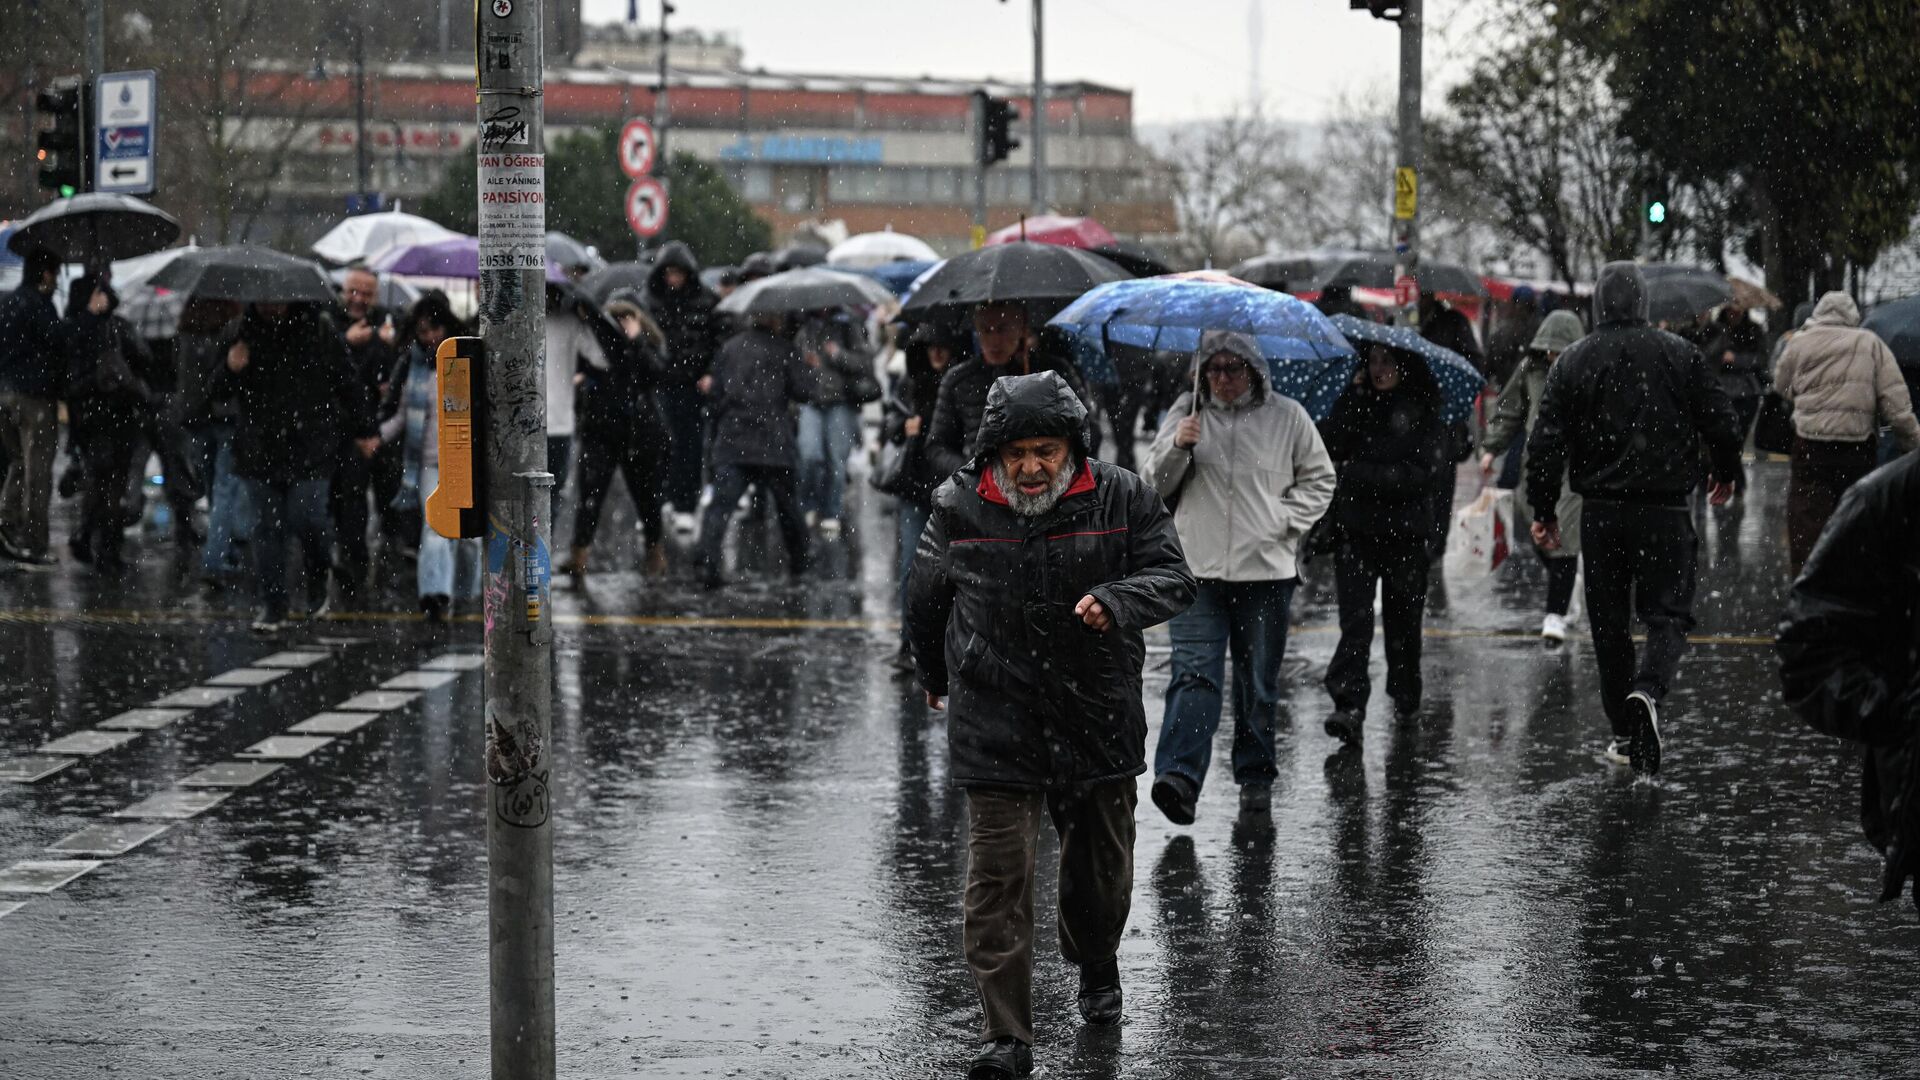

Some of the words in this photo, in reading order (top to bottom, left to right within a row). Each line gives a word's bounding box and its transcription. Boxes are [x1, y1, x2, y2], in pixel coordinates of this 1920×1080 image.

[479, 156, 500, 168] YAN
[487, 176, 504, 185] AİLE
[505, 177, 540, 185] YANINDA
[483, 190, 544, 204] PANSİYON
[486, 255, 514, 267] 0538
[518, 255, 538, 267] 706
